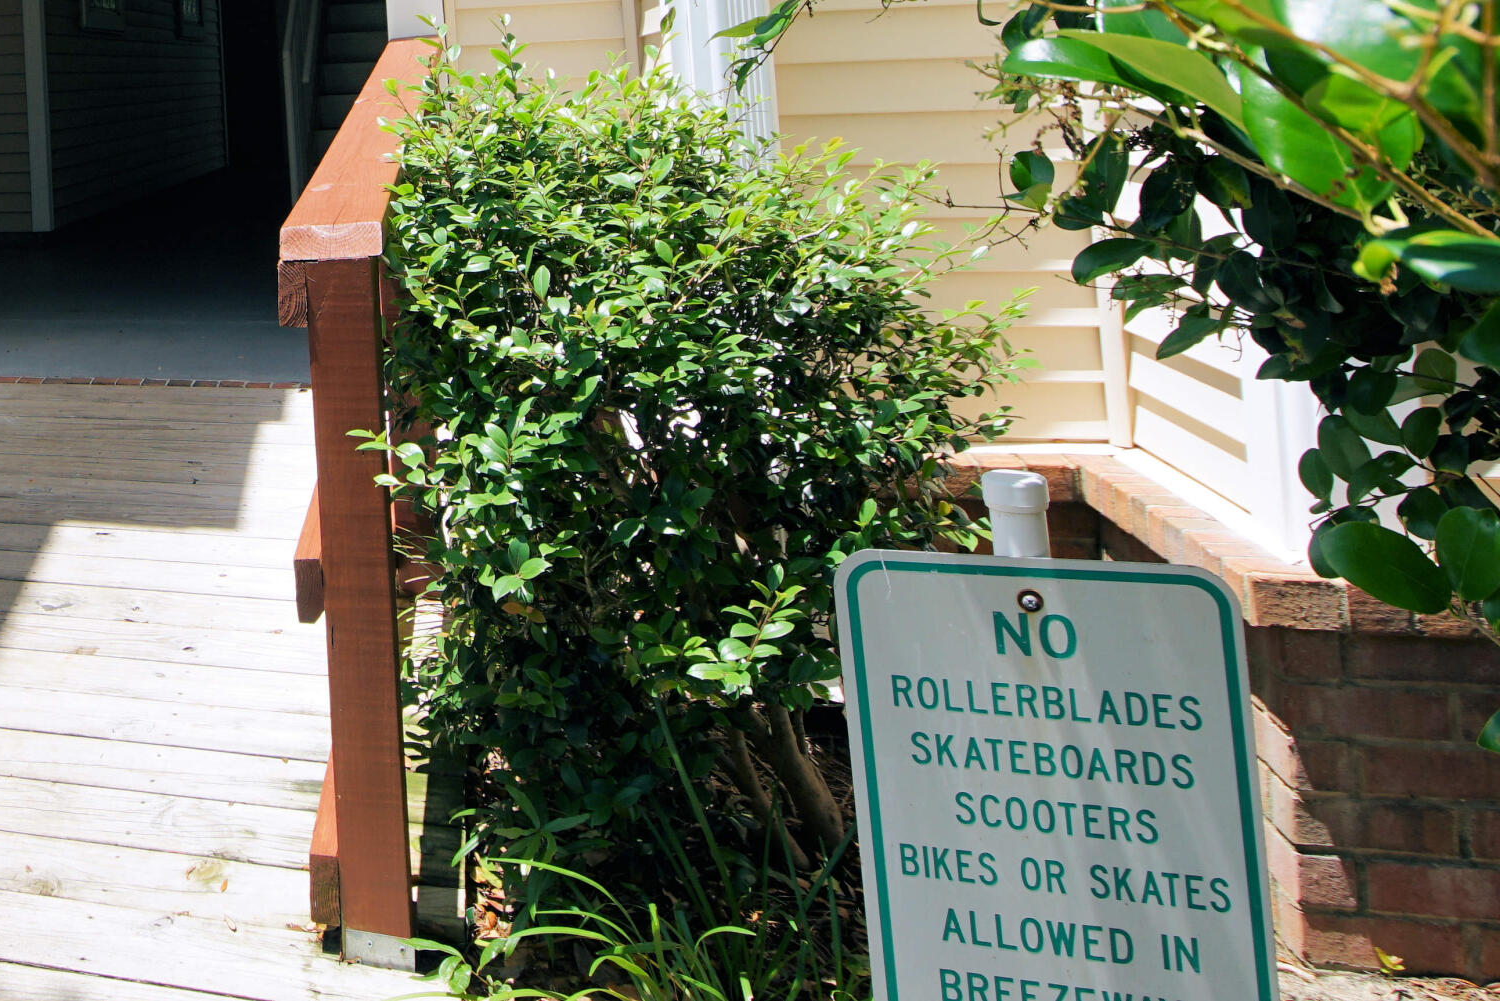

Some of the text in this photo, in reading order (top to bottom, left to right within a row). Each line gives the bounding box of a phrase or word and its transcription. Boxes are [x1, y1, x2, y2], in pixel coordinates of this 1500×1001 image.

[993, 611, 1079, 660] NO
[891, 674, 1204, 732] ROLLERBLADES
[911, 731, 1196, 791] SKATEBOARDS
[955, 791, 1160, 846] SCOOTERS
[899, 843, 1233, 914] BIKES OR SKATES
[943, 908, 1202, 974] ALLOWED IN
